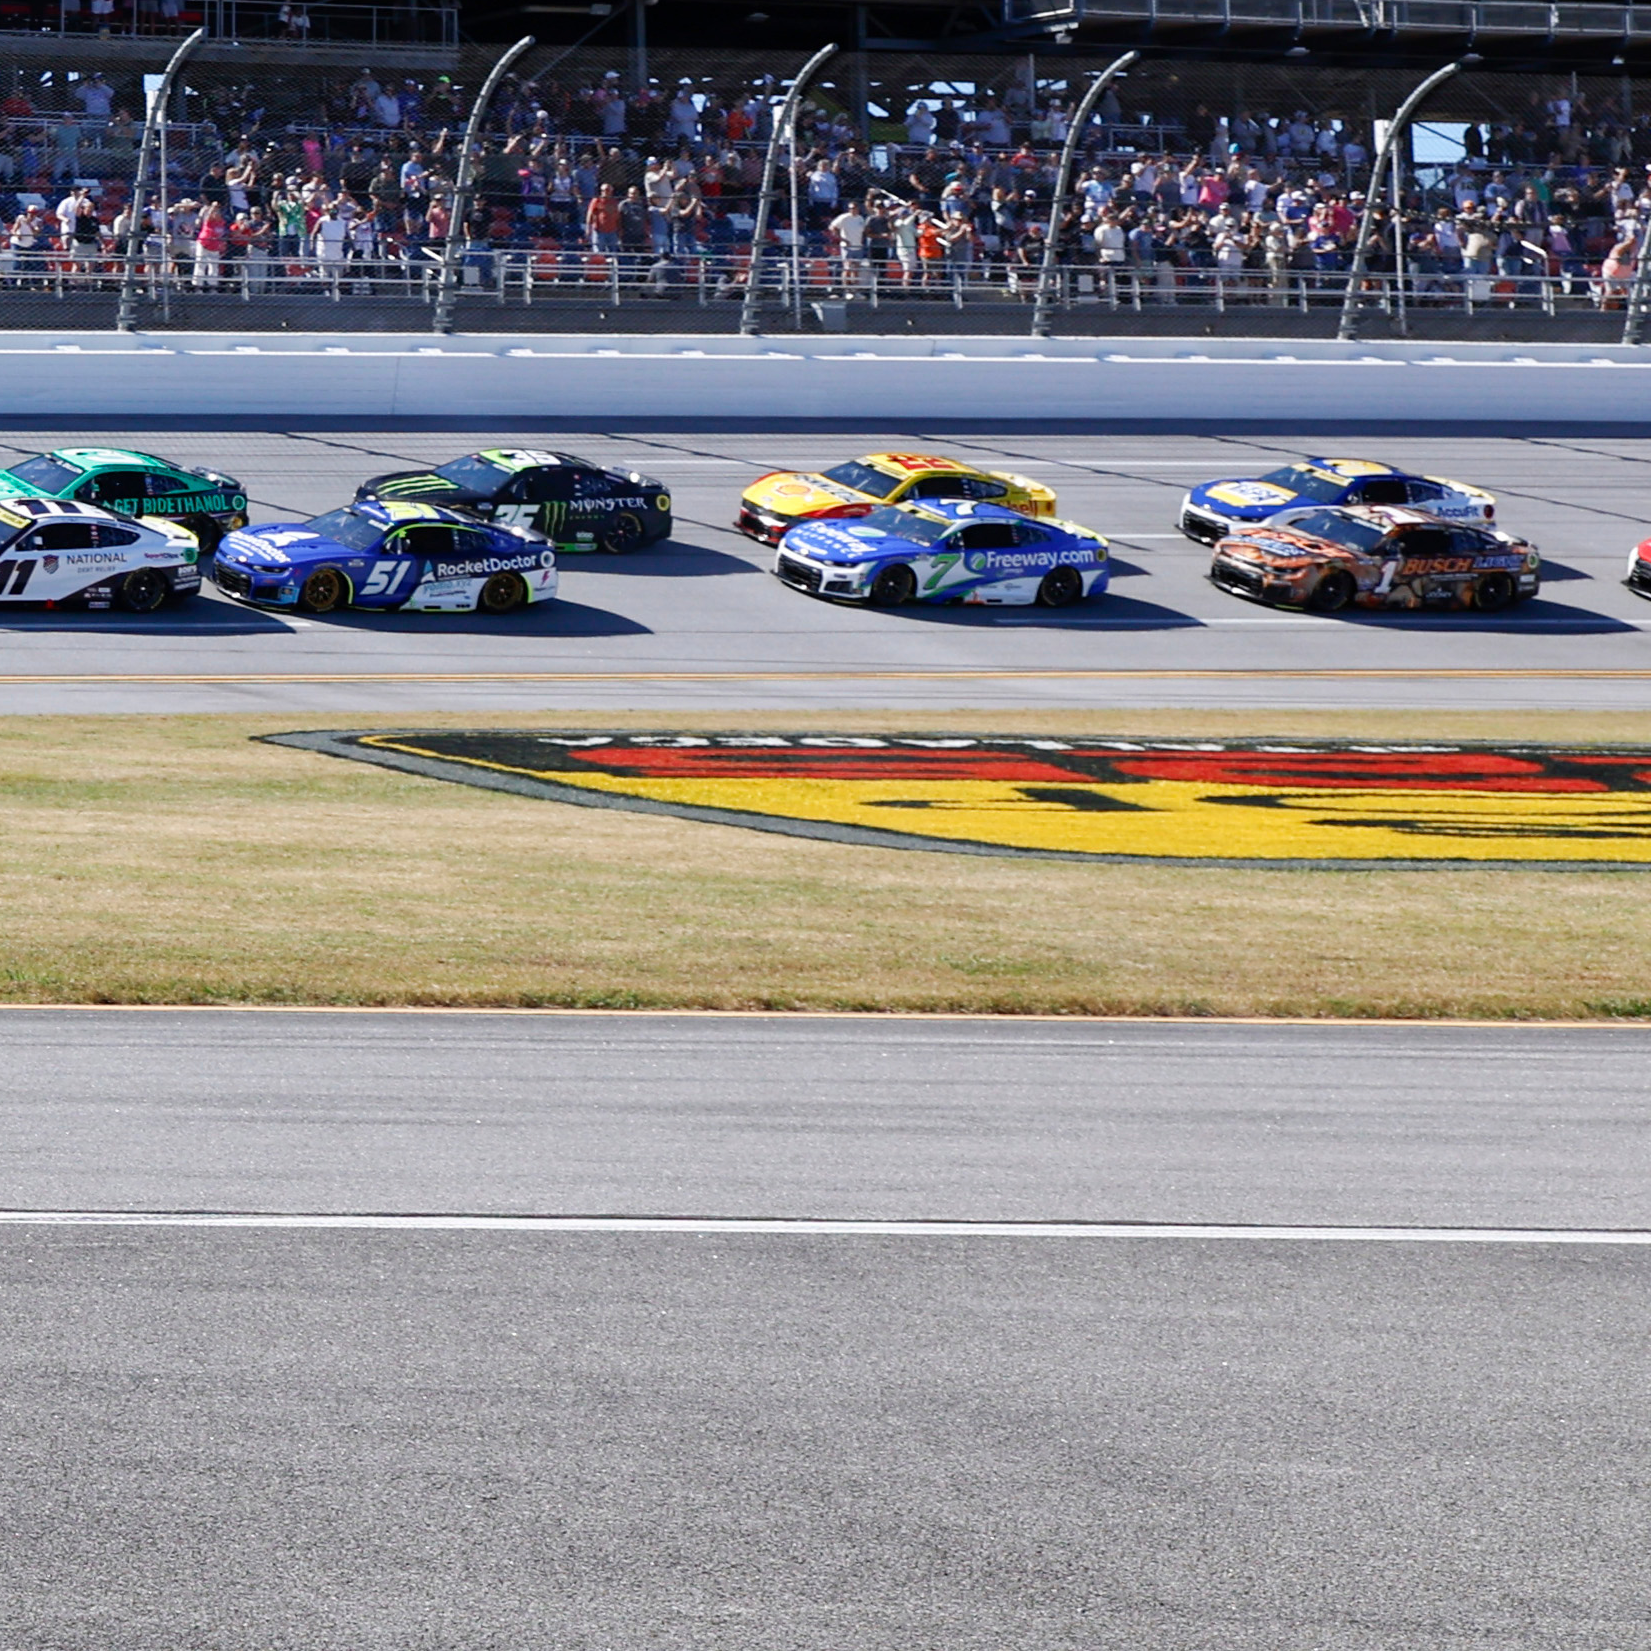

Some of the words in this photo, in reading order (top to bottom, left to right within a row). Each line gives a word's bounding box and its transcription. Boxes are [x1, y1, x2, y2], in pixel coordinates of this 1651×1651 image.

[570, 497, 648, 511] MONSTER
[66, 552, 127, 564] NATIONAL
[437, 554, 537, 577] RocketDoctor
[986, 549, 1095, 569] Freeway.com
[1402, 558, 1474, 576] BUSCH
[360, 560, 412, 597] 51
[922, 553, 961, 591] 7
[1373, 559, 1398, 594] 1
